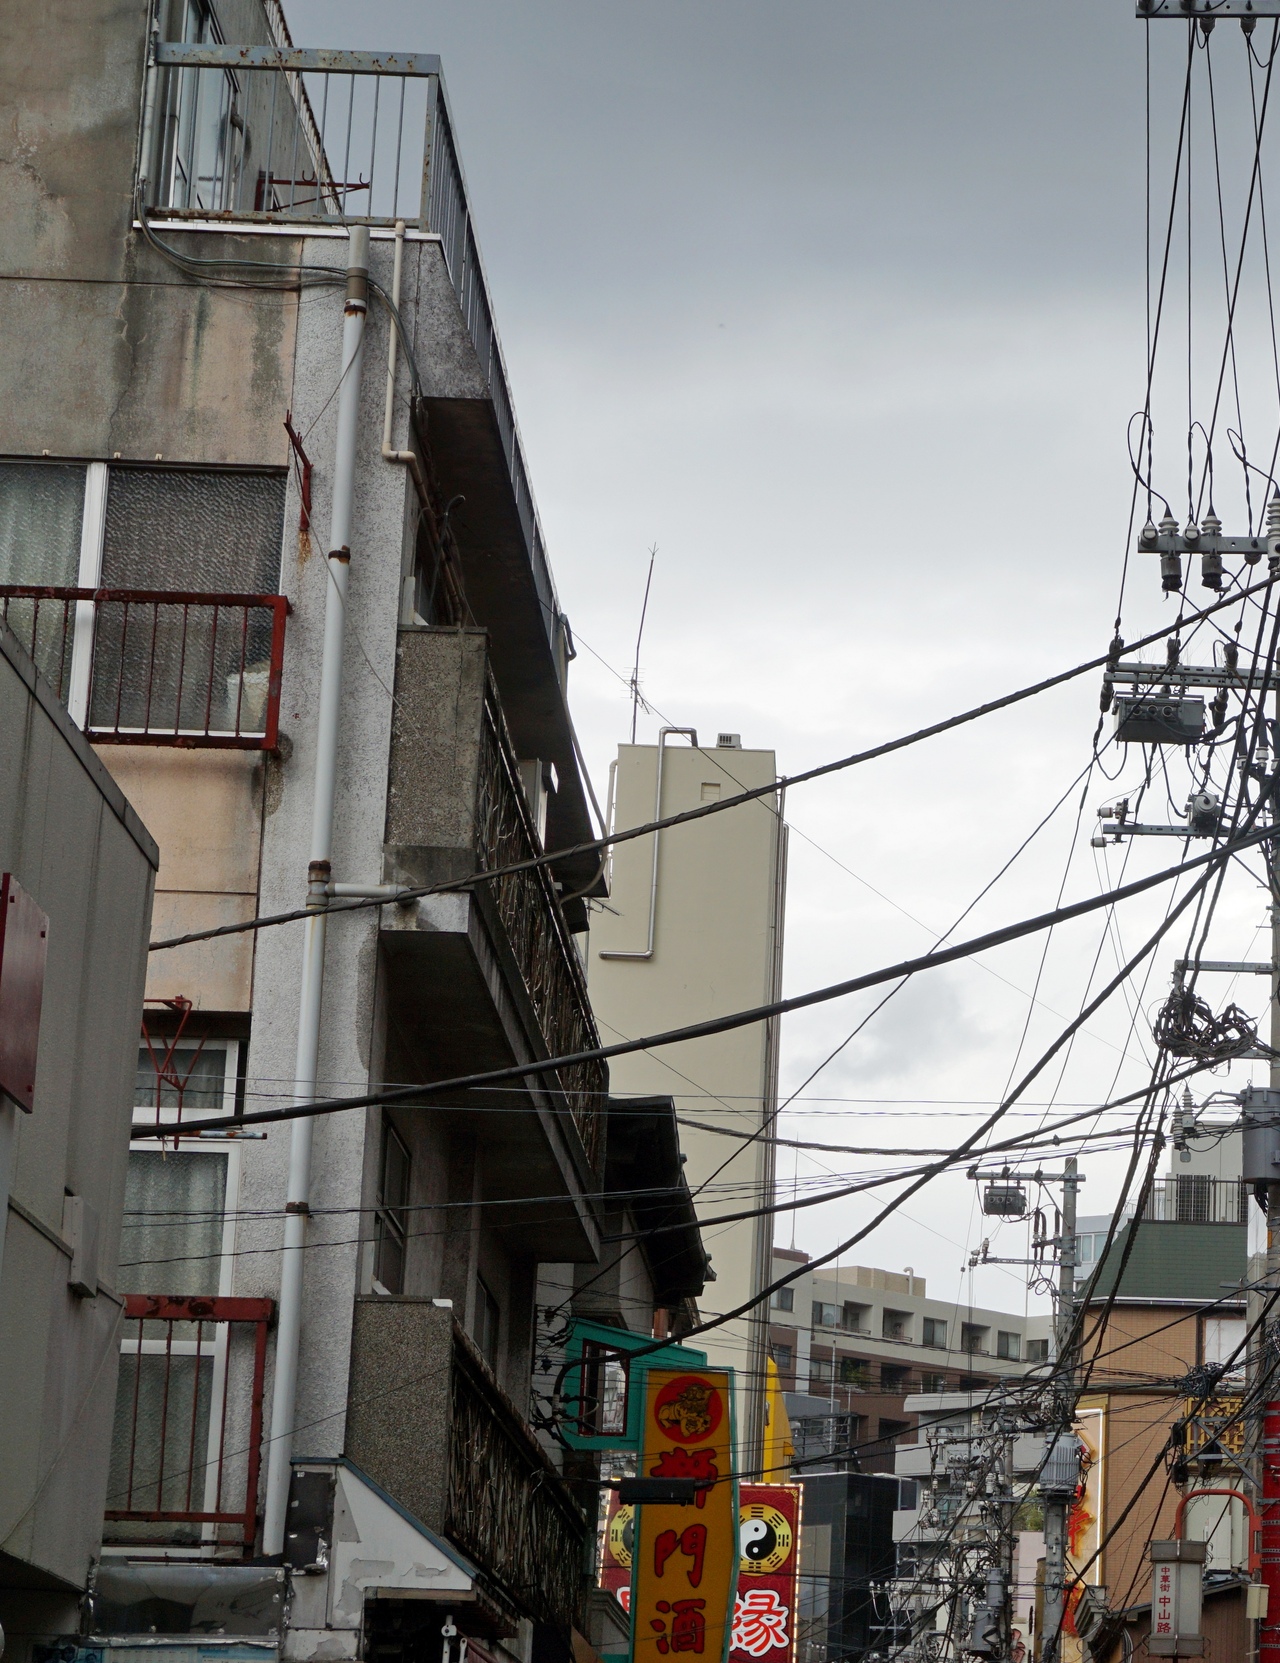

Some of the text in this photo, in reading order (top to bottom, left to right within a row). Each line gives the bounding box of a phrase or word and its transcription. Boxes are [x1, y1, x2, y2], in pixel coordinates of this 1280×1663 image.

[1157, 1566, 1171, 1634] 中華街 中山路
